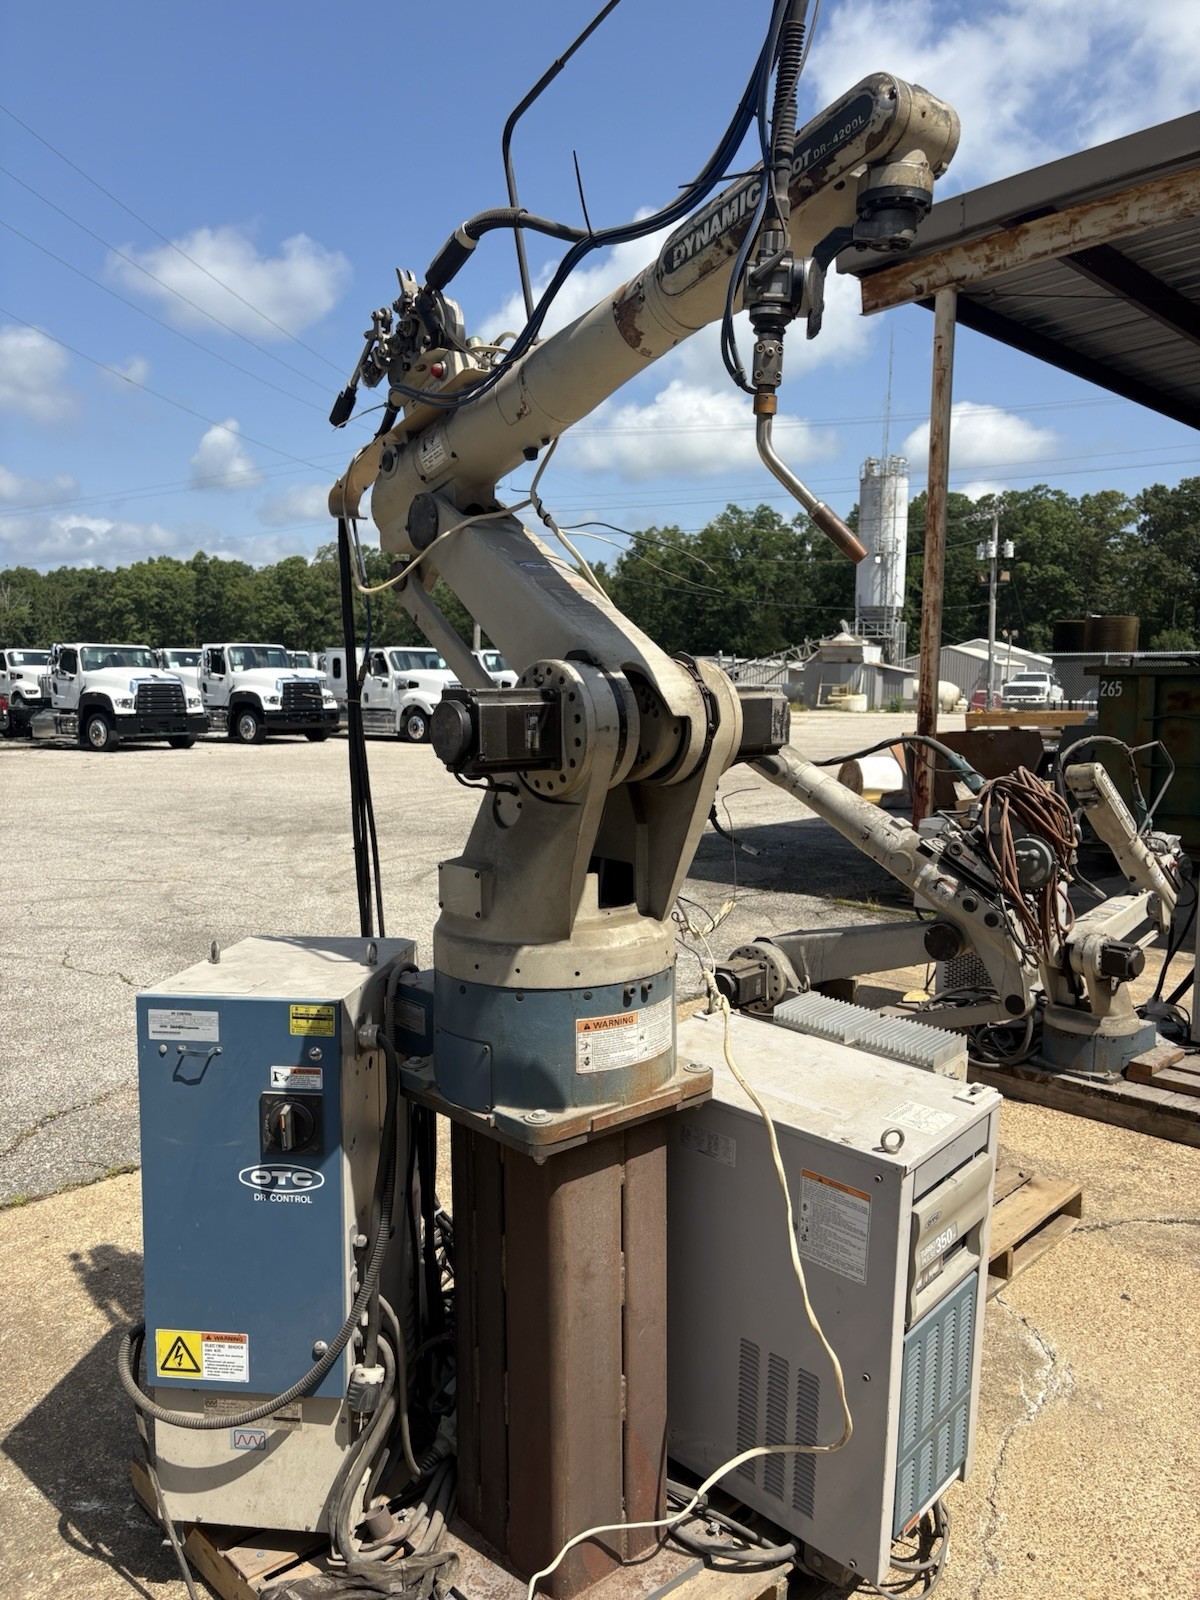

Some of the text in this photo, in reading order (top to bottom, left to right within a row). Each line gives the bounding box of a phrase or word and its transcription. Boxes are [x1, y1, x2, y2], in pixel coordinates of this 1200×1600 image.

[673, 115, 865, 268] DYNAMIC DR-4200L
[1100, 680, 1122, 697] 265
[593, 1015, 634, 1030] WARNING
[250, 1170, 313, 1187] OTC
[253, 1193, 313, 1204] DR CONTROL
[935, 1227, 953, 1254] 350
